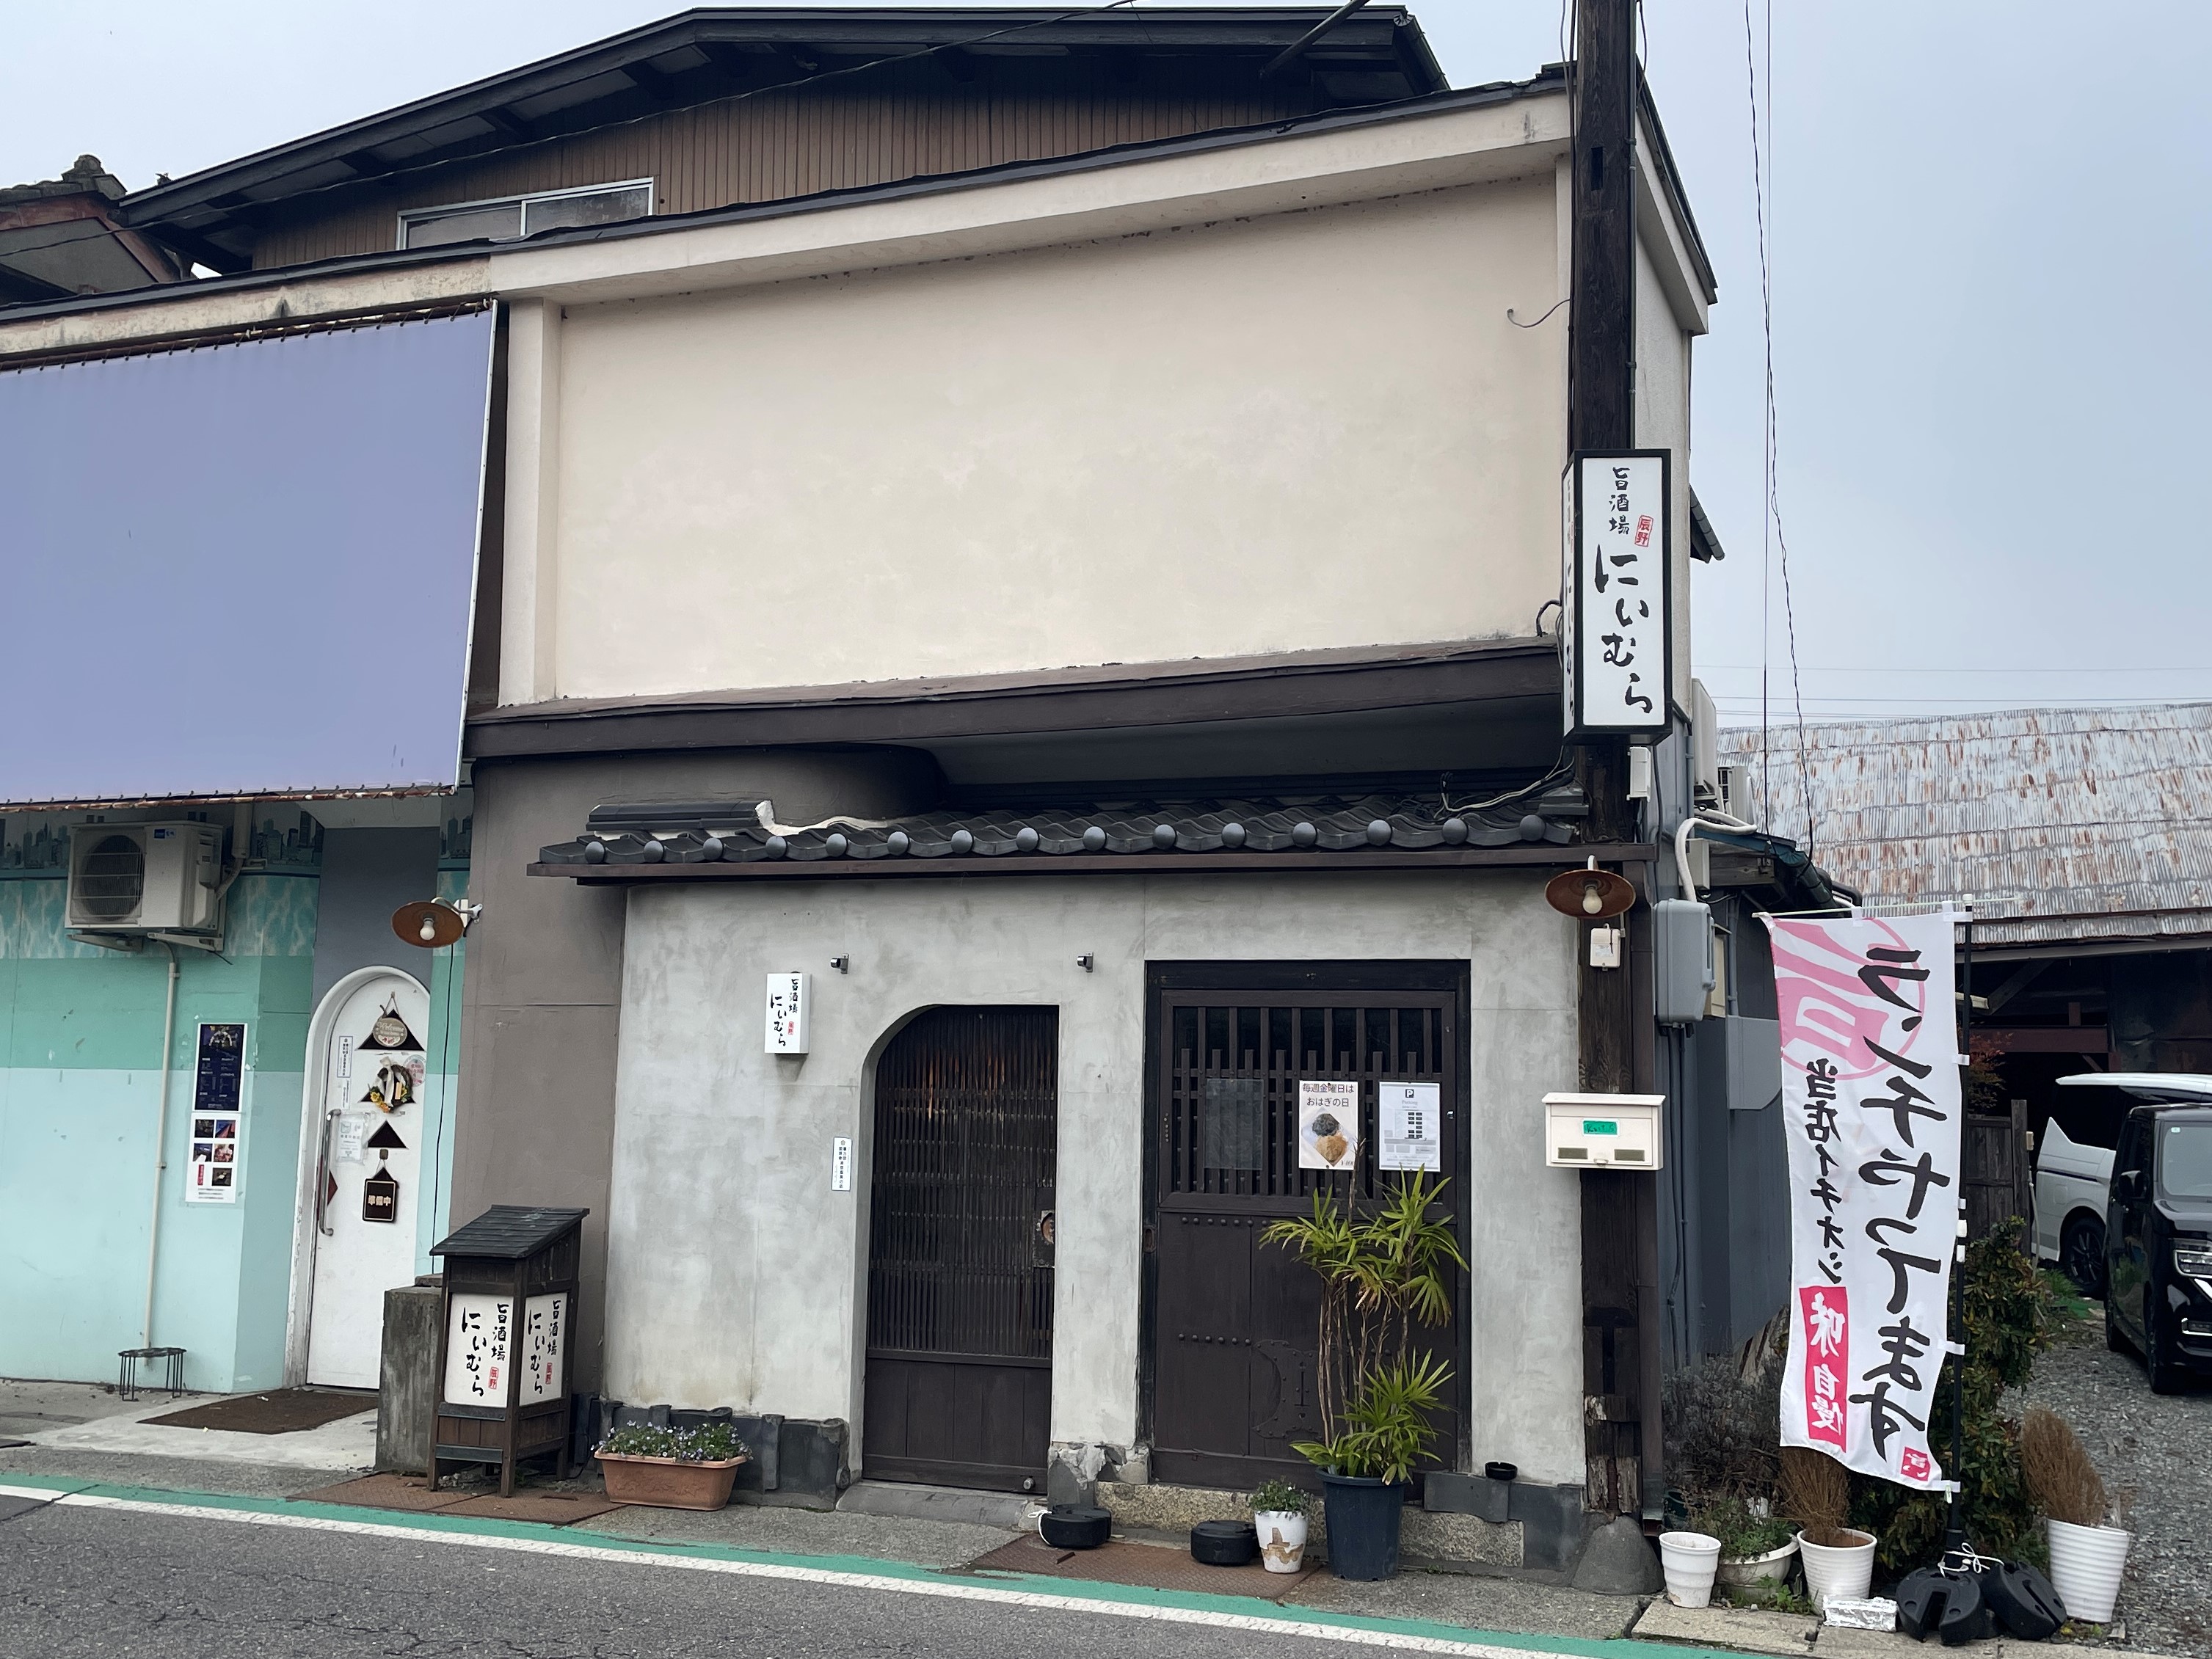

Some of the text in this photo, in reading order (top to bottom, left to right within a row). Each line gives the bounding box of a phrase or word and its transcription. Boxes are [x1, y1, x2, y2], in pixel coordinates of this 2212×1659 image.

[1608, 467, 1630, 535] 旨酒場
[1635, 515, 1653, 547] 辰野
[1594, 544, 1652, 713] にいむら
[770, 993, 787, 1047] にいむら
[1303, 1083, 1354, 1093] 毎週金曜日は
[1307, 1097, 1349, 1107] おはぎの日
[462, 1307, 487, 1397] にいむら
[491, 1302, 509, 1361] 旨酒場
[528, 1309, 545, 1394] にいむら
[547, 1299, 561, 1355] 旨酒場
